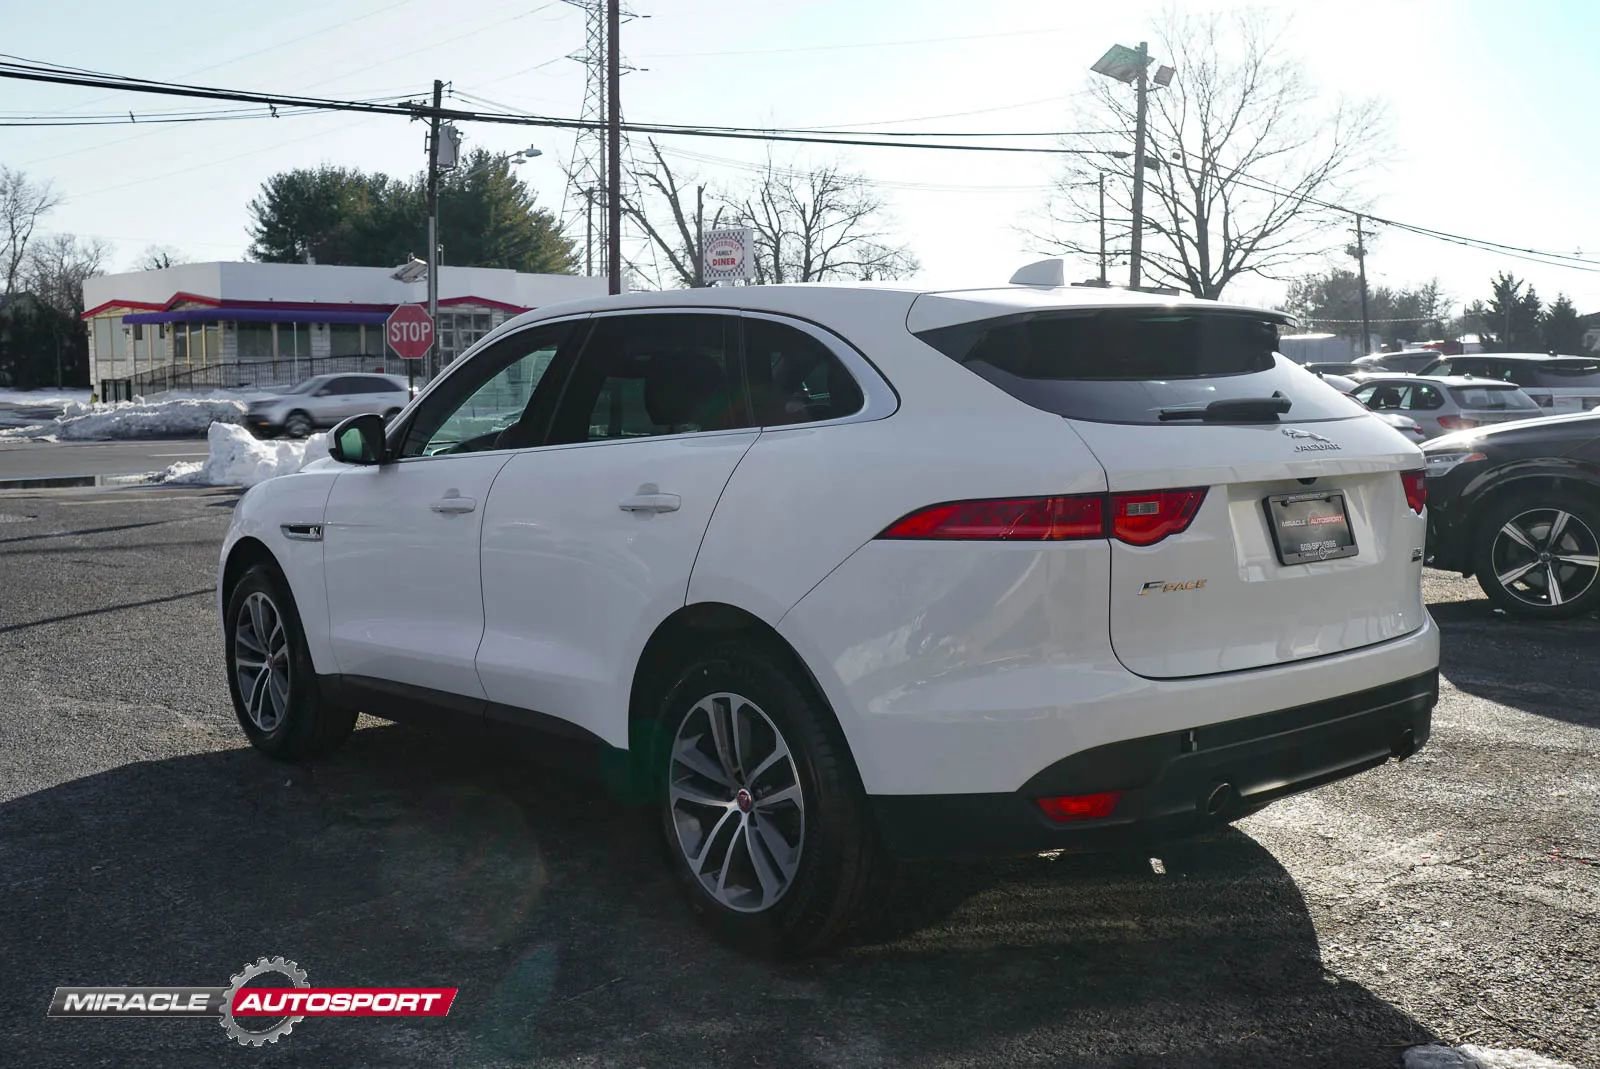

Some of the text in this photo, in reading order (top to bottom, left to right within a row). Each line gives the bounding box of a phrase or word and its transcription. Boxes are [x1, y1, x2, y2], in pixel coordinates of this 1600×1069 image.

[712, 258, 736, 266] DINER
[391, 322, 431, 342] STOP
[1294, 443, 1342, 453] JAGUAR
[1281, 516, 1342, 528] MIRACLE AUTOSPORT
